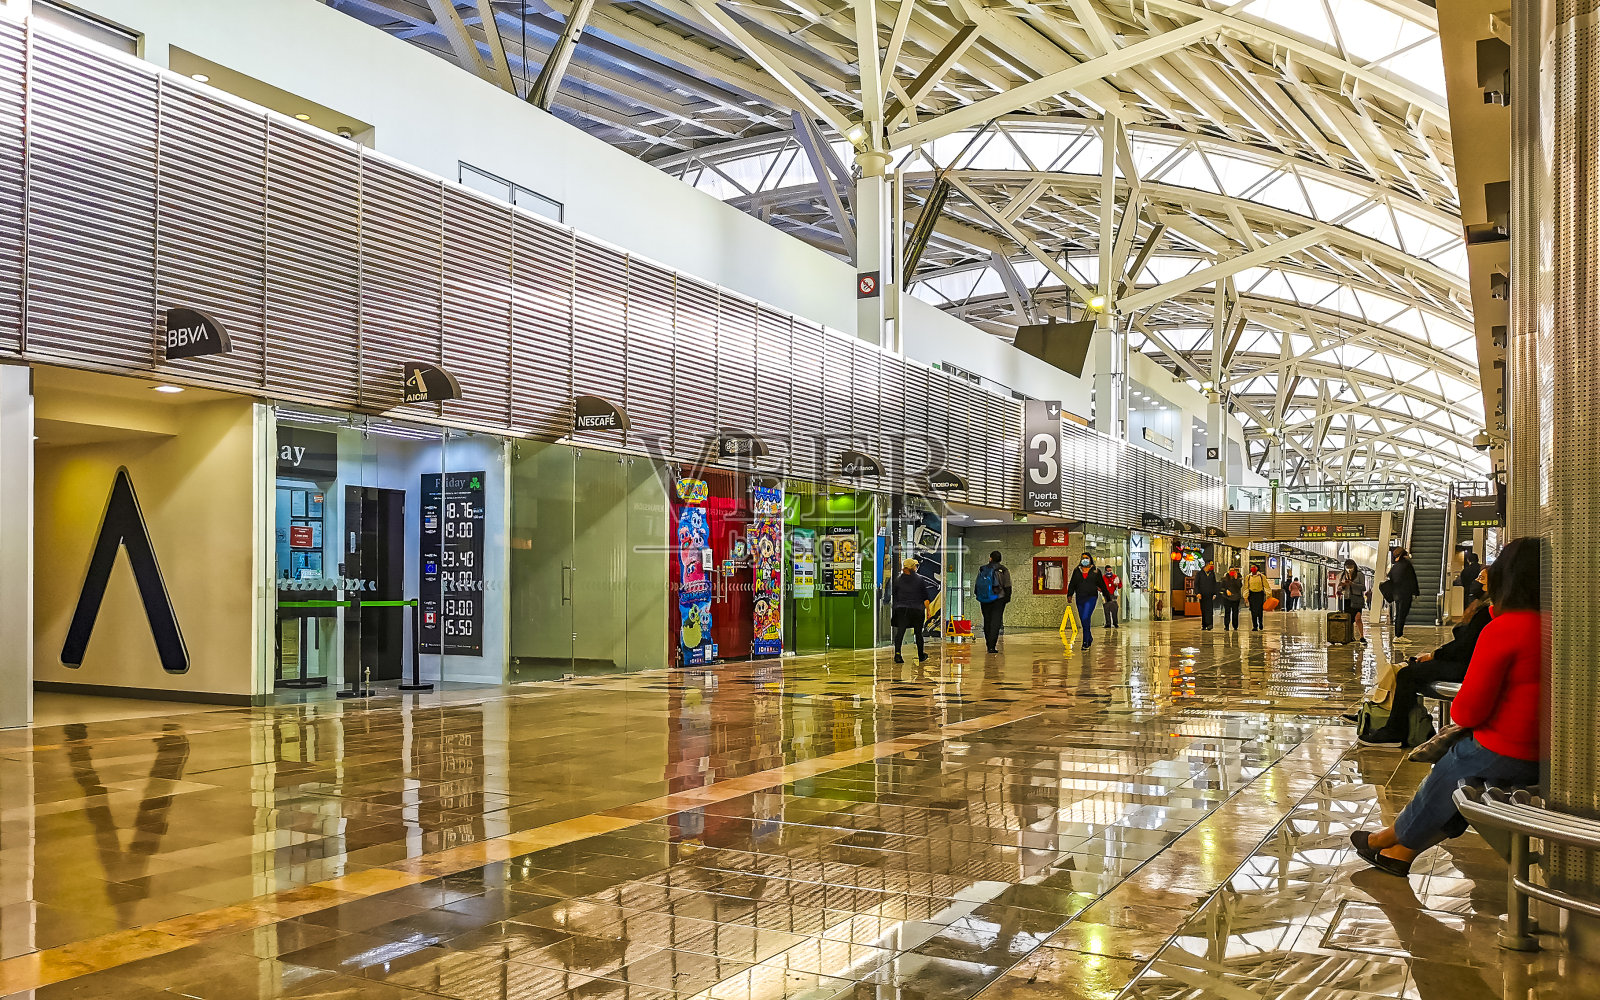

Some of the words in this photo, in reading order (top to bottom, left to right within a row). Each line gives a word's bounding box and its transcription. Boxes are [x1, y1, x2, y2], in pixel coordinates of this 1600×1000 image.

[168, 322, 209, 348] BBVA
[406, 392, 428, 401] AICM
[578, 411, 616, 427] NESCAFÉ
[276, 445, 306, 467] ay
[1029, 432, 1058, 485] 3
[435, 477, 466, 490] Fiday
[1028, 491, 1058, 500] Puerta
[446, 502, 473, 519] 18.76
[1033, 500, 1052, 508] Door
[445, 521, 473, 538] 19.00
[1338, 541, 1350, 559] 4
[441, 551, 474, 567] 23.40
[445, 600, 473, 616] 13.00
[445, 619, 473, 636] 15.50
